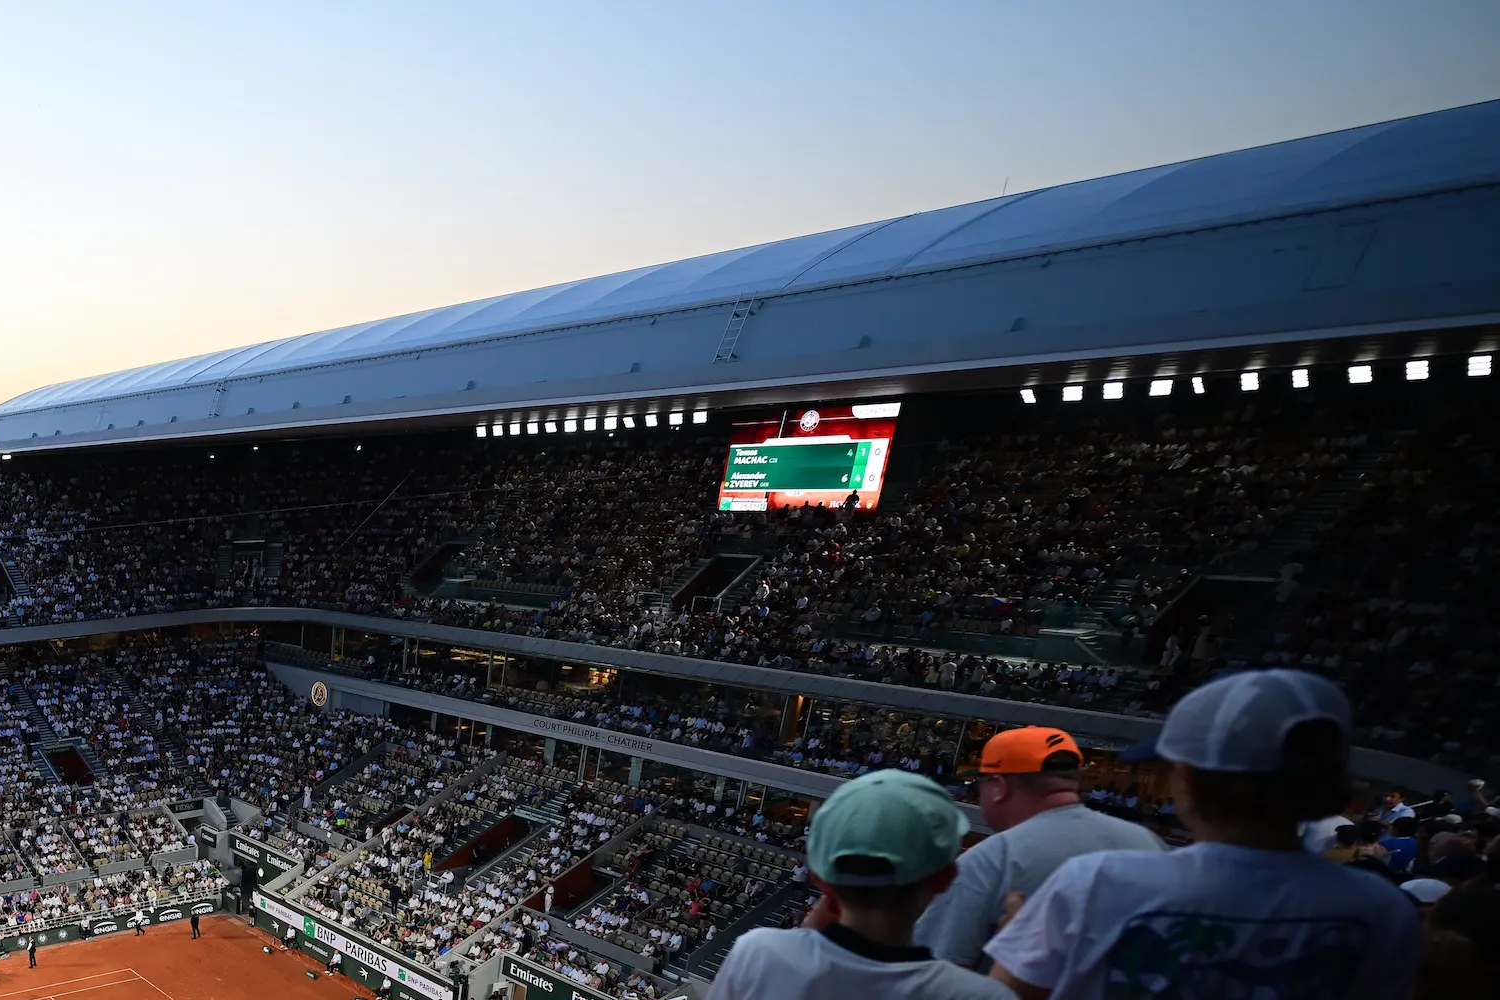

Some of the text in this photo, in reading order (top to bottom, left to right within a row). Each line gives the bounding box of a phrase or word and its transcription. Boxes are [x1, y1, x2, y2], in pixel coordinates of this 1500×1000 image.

[735, 448, 758, 456] Tomas
[847, 449, 853, 457] 4
[861, 448, 866, 456] 1
[733, 456, 768, 464] MACHAC
[731, 472, 767, 480] Alexander
[841, 474, 848, 483] 6
[854, 474, 861, 482] 4
[729, 480, 759, 488] ZVEREV
[533, 720, 560, 732] COURT
[563, 725, 601, 740] PHILIPPE
[607, 735, 653, 751] CHATRIER
[236, 839, 260, 858] Emirates
[266, 854, 292, 871] Emirates
[317, 926, 387, 972] BNP PARIBAS
[510, 962, 554, 992] Emirates
[407, 975, 443, 998] BNP PARIBAS
